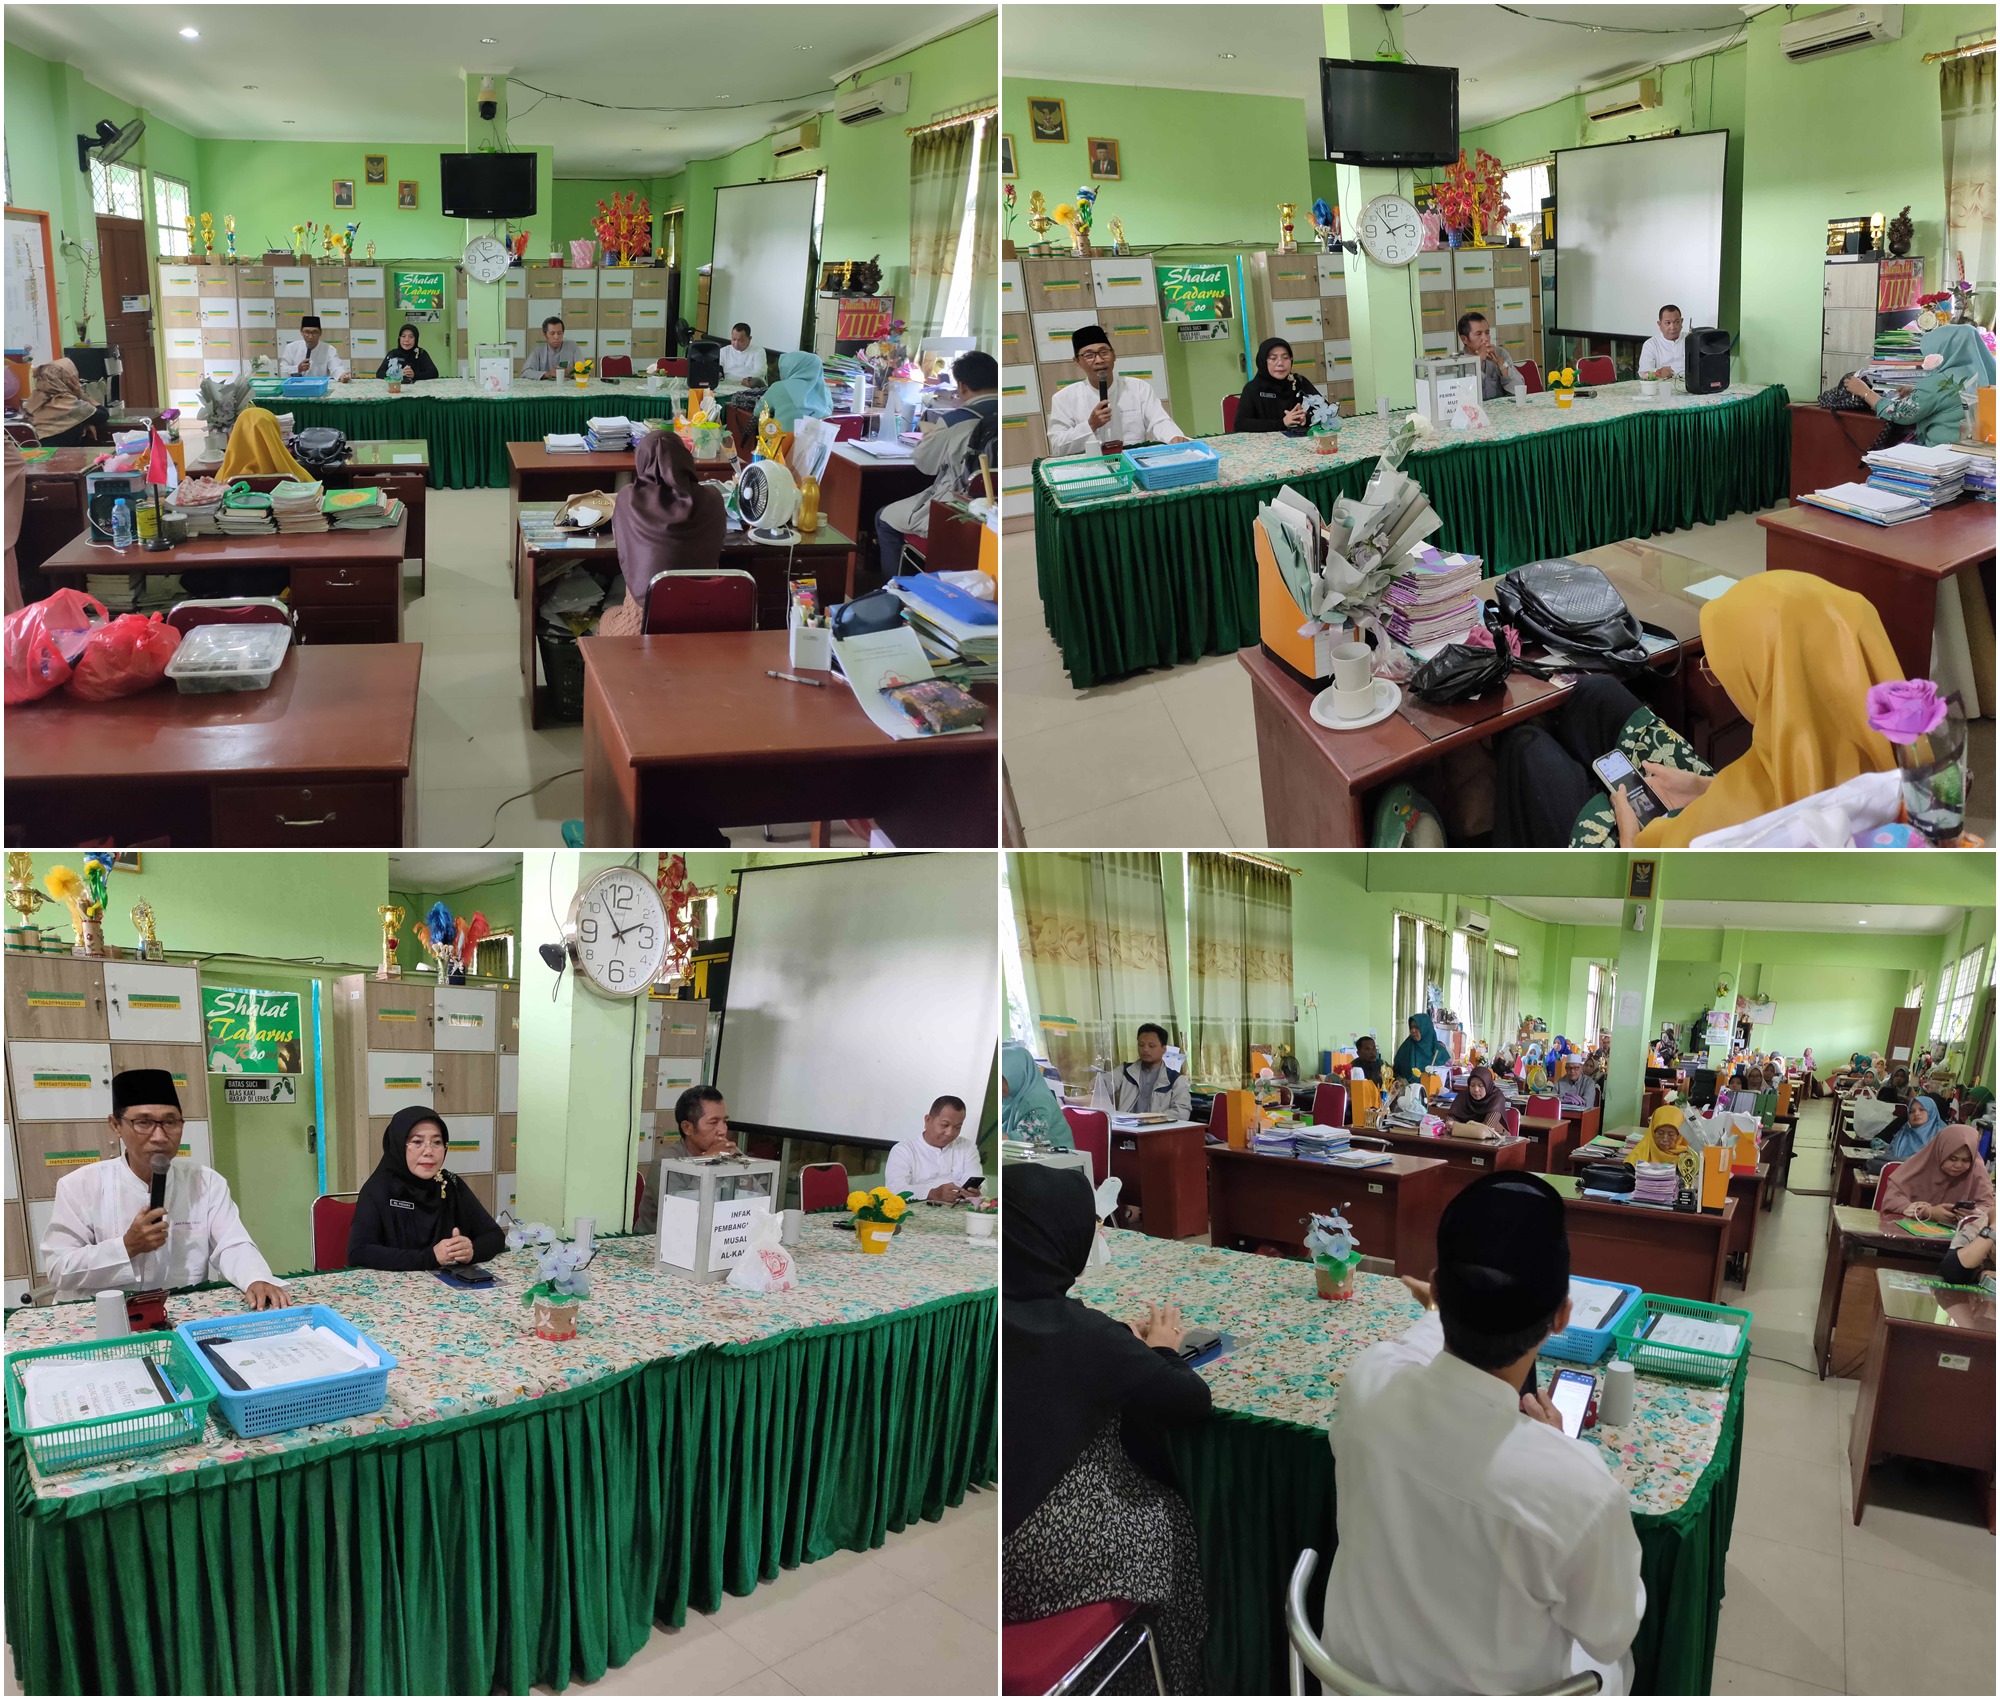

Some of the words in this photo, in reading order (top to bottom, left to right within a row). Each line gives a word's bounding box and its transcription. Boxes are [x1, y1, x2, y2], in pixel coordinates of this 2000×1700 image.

[1381, 204, 1399, 217] 12
[1366, 225, 1377, 238] 9
[1405, 225, 1415, 237] 3
[481, 241, 493, 251] 12
[1387, 245, 1398, 258] 6
[468, 255, 476, 264] 9
[496, 255, 504, 264] 3
[482, 269, 490, 277] 6
[1163, 268, 1221, 286] Shalat
[399, 274, 439, 286] Shalat
[399, 285, 441, 295] Tadarus
[1164, 285, 1225, 301] Tadarus
[600, 889, 608, 900] 11
[609, 883, 633, 910] 12
[636, 893, 640, 904] 1
[588, 902, 600, 913] 10
[642, 908, 650, 919] 2
[581, 919, 597, 943] 9
[638, 926, 654, 949] 3
[585, 949, 594, 960] 8
[640, 955, 647, 964] 4
[597, 964, 604, 975] 7
[608, 960, 624, 983] 6
[629, 967, 636, 978] 5
[206, 992, 289, 1018] Shalat
[207, 1017, 294, 1043] Tadarus
[731, 1209, 751, 1218] INFAK
[714, 1222, 749, 1233] PEMBANG
[720, 1250, 745, 1259] AL-KA
